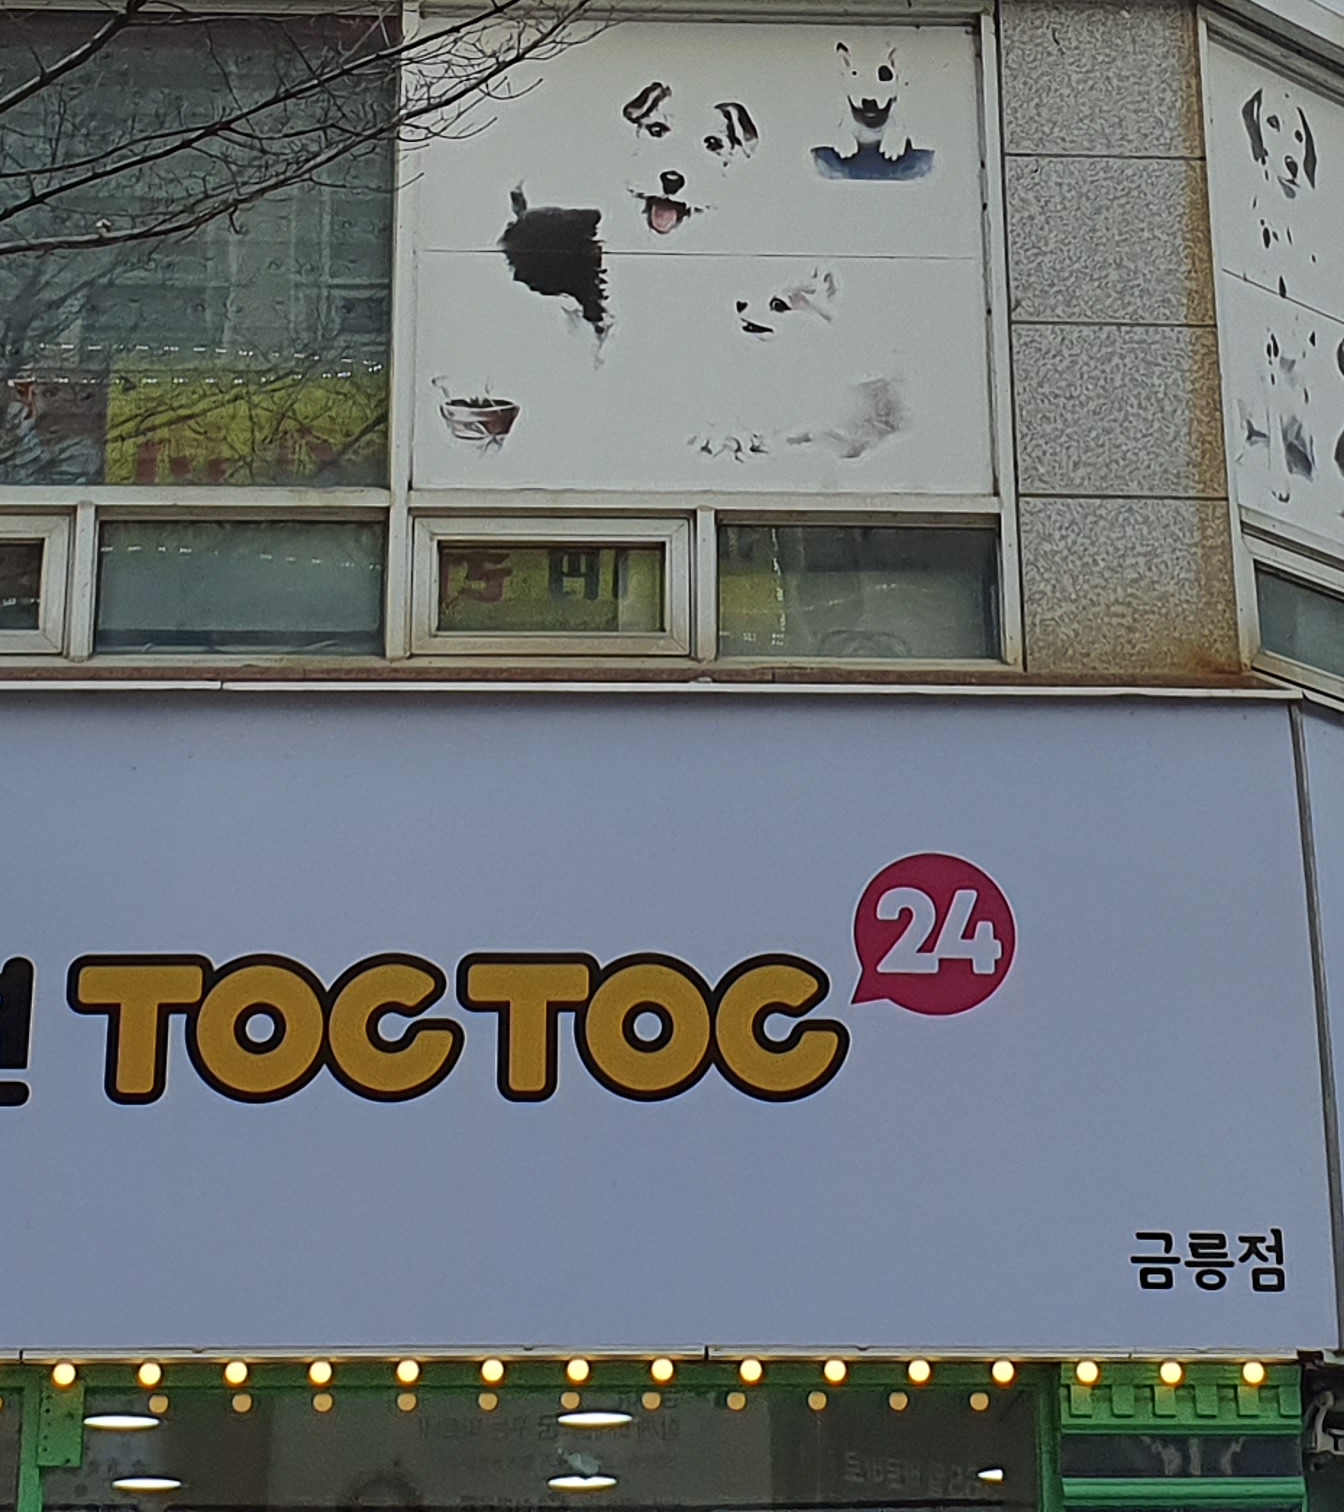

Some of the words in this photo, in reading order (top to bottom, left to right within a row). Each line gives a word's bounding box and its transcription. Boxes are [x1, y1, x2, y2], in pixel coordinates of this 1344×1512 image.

[66, 952, 850, 1106] TOCTOC
[874, 886, 1004, 977] 24
[1129, 1227, 1286, 1293] 금릉점
